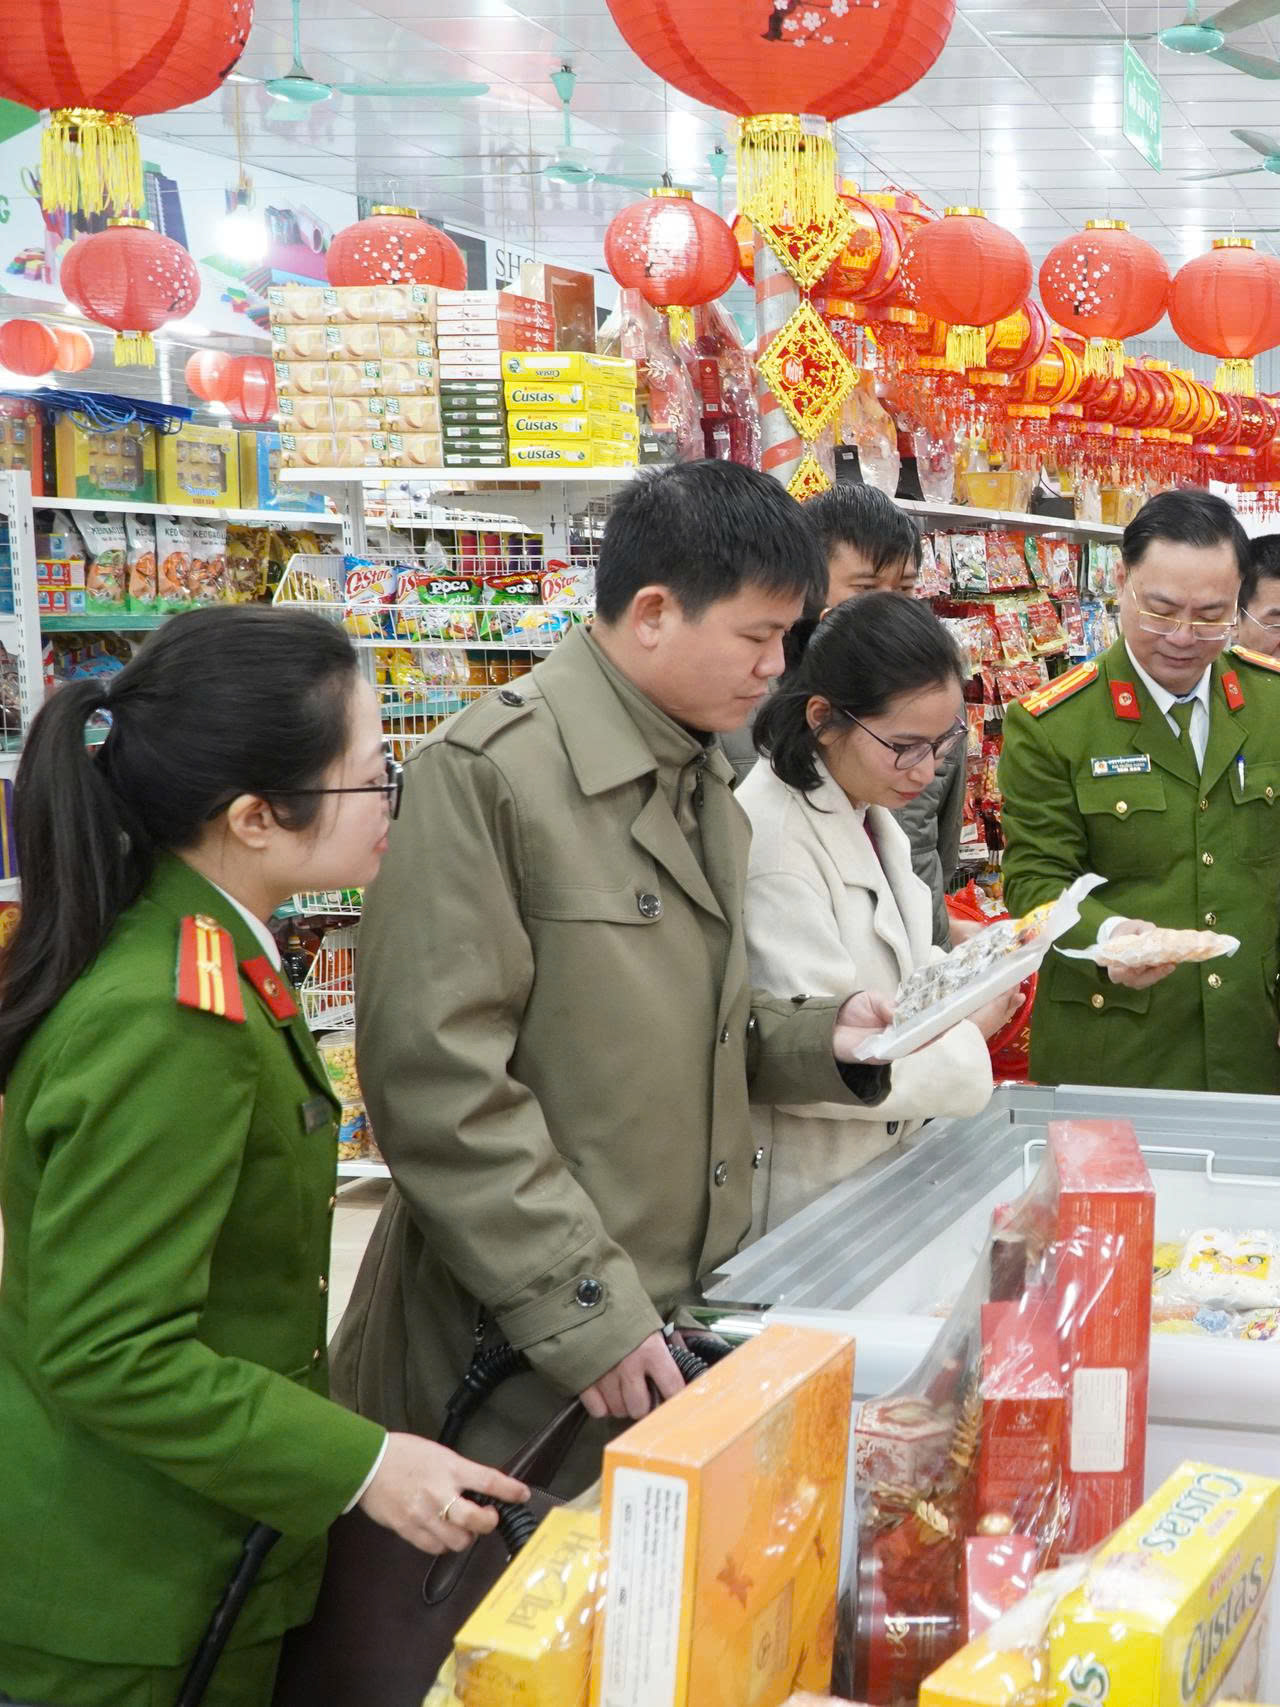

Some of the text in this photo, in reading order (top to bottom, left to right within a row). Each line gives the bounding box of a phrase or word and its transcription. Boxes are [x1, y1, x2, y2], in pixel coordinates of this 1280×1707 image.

[496, 249, 533, 280] SH
[512, 390, 555, 403] Custas
[516, 419, 558, 431] Custas
[517, 449, 561, 460] Custas
[1142, 1472, 1243, 1552] Custas
[1181, 1555, 1264, 1702] Custas
